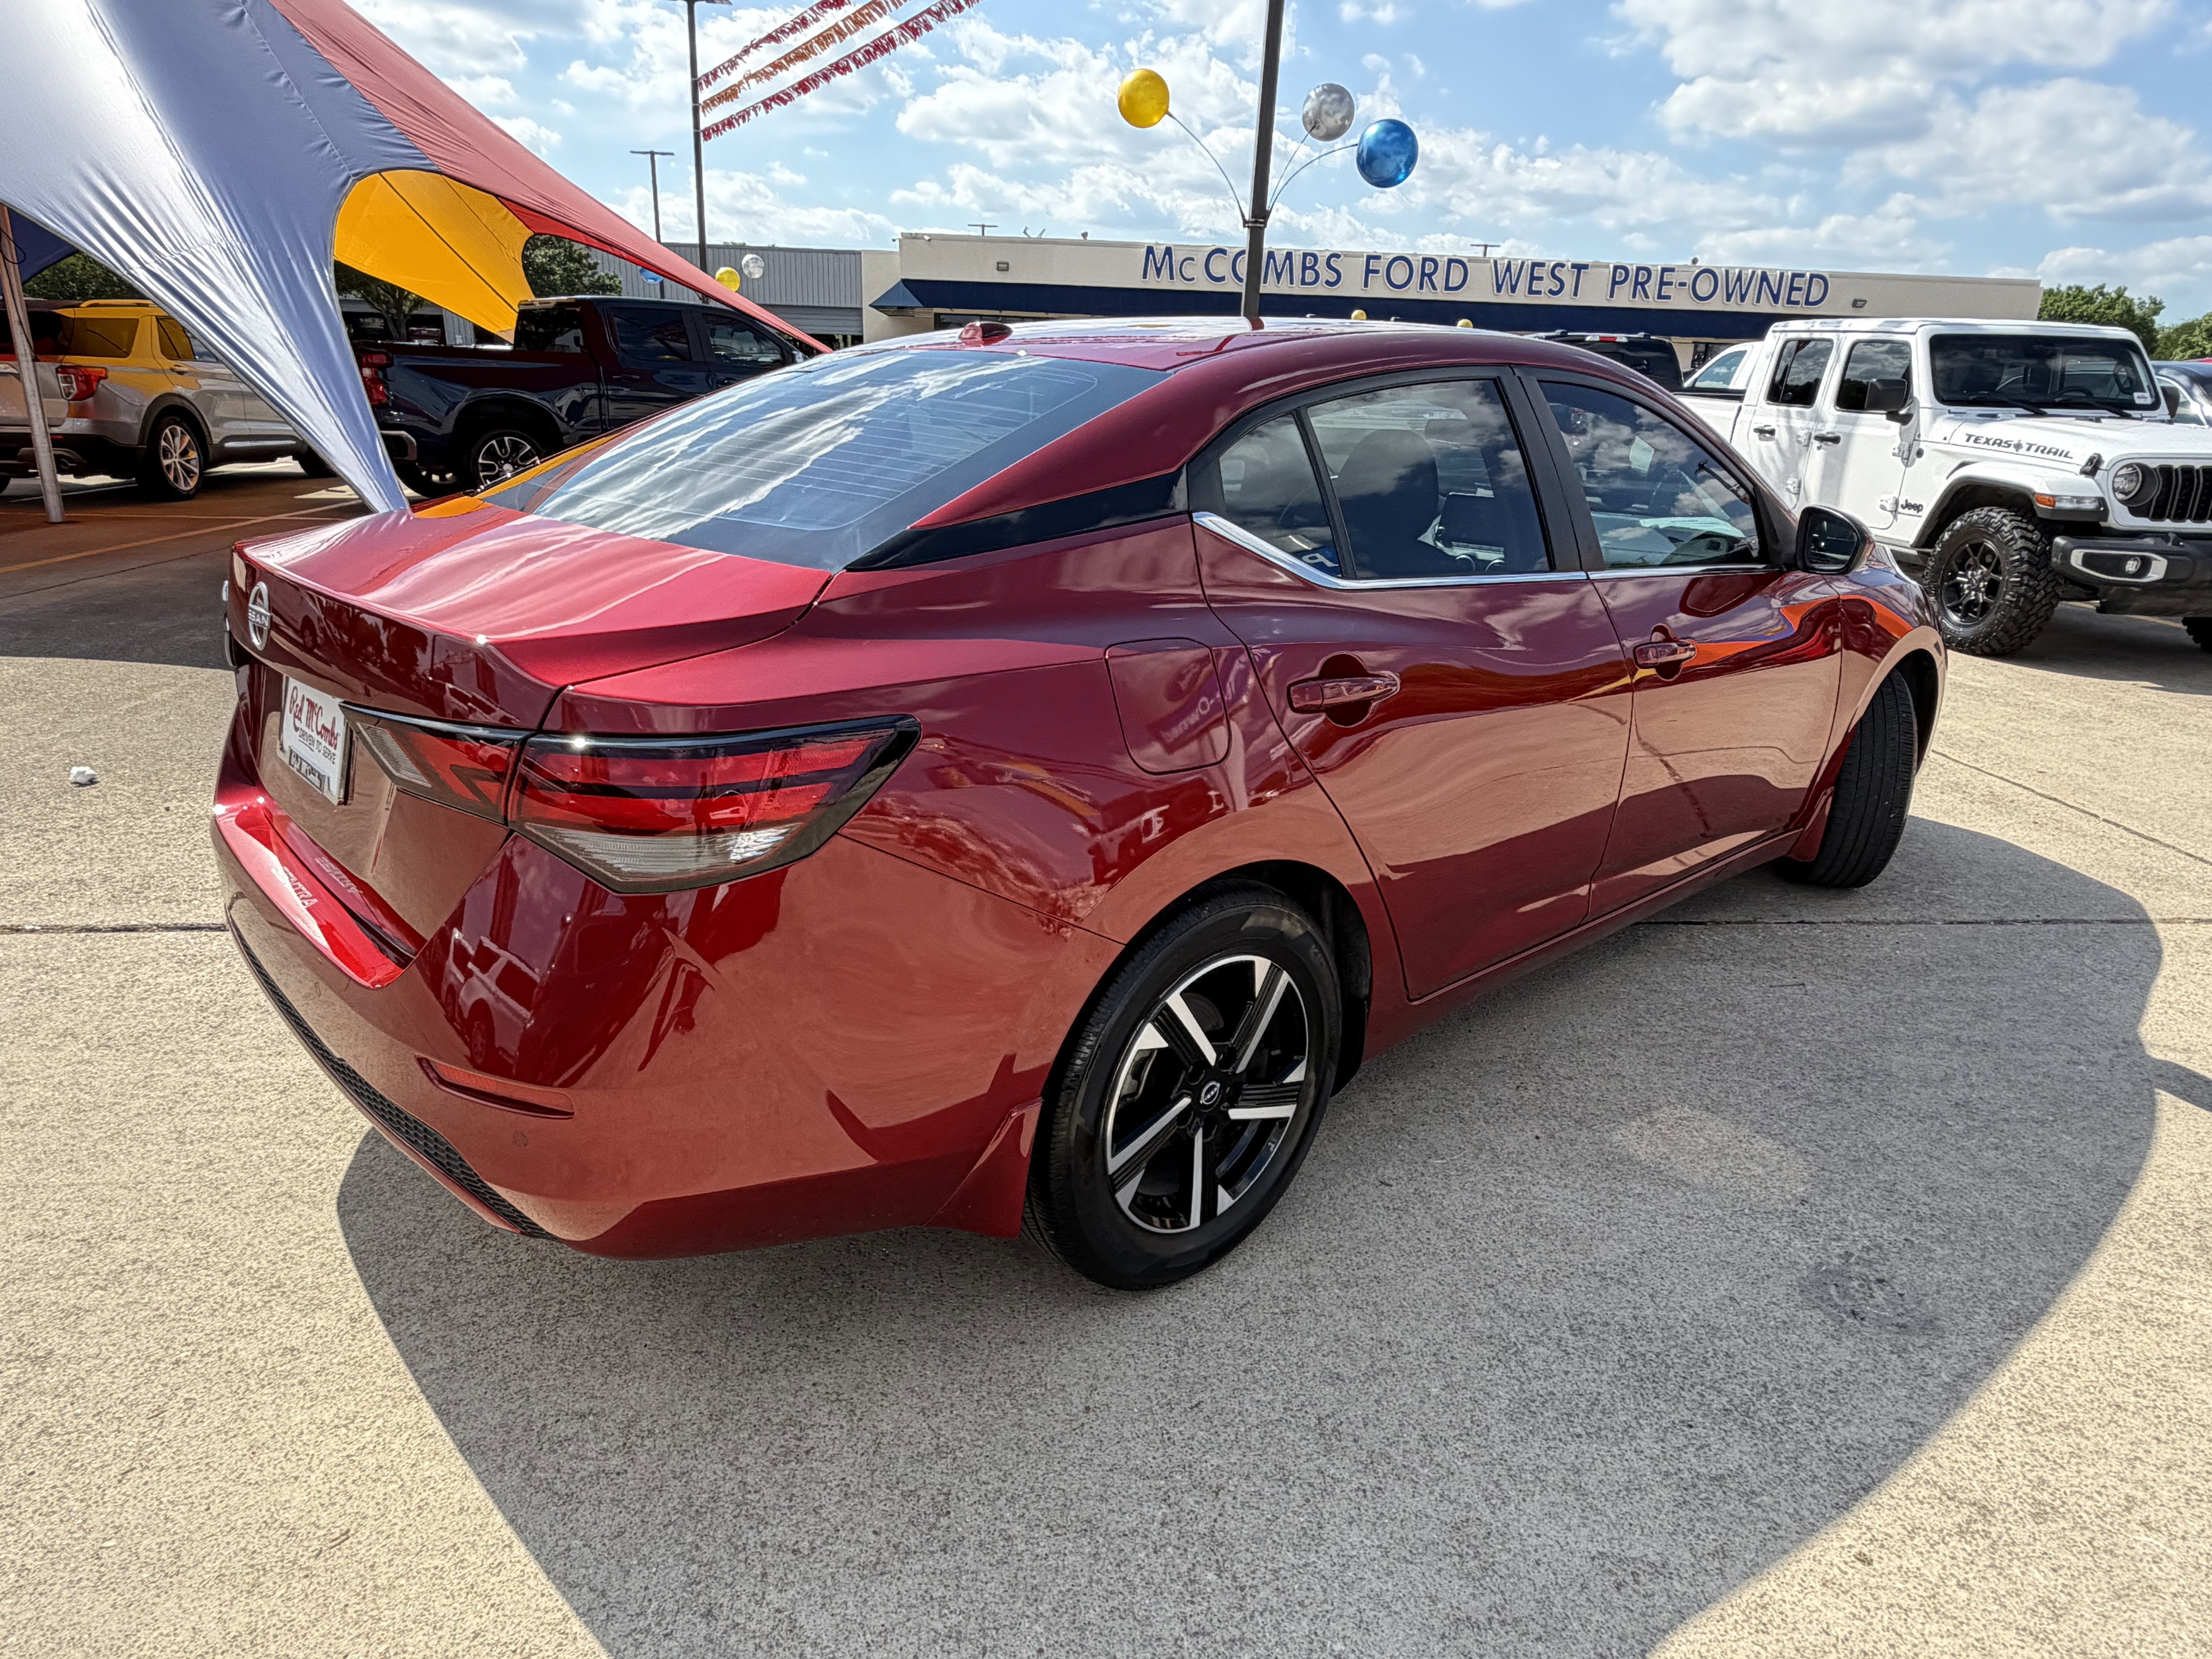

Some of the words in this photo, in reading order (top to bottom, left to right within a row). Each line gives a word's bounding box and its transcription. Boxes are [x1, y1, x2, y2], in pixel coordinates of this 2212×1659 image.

[1363, 254, 1469, 291] FORD
[1493, 259, 1590, 297] WEST
[1609, 265, 1829, 307] PRE-OWNED
[1965, 433, 2014, 448] TEXAS
[2025, 442, 2073, 459] TRAIL
[1901, 499, 1923, 514] Jeep
[289, 685, 305, 733] Red
[316, 740, 322, 753] TO
